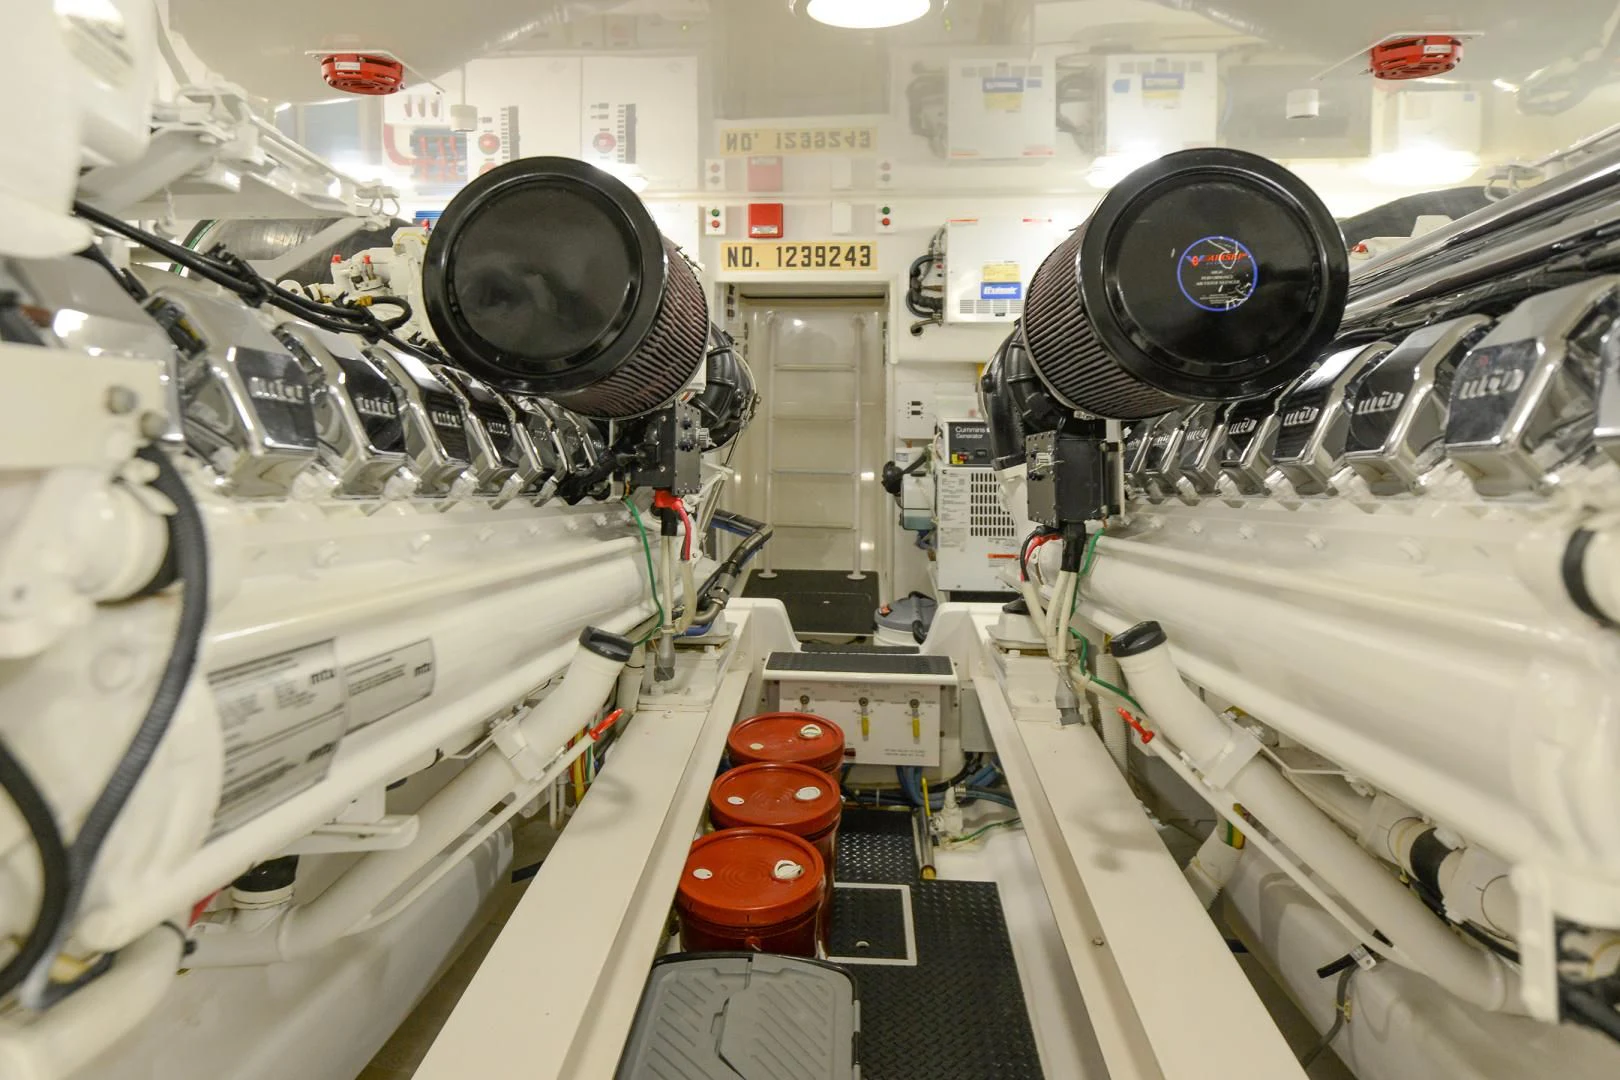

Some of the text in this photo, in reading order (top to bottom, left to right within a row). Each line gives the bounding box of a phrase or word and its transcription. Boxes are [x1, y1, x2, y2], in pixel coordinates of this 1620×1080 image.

[727, 245, 871, 267] NO. 1239243
[955, 425, 985, 434] Cummins
